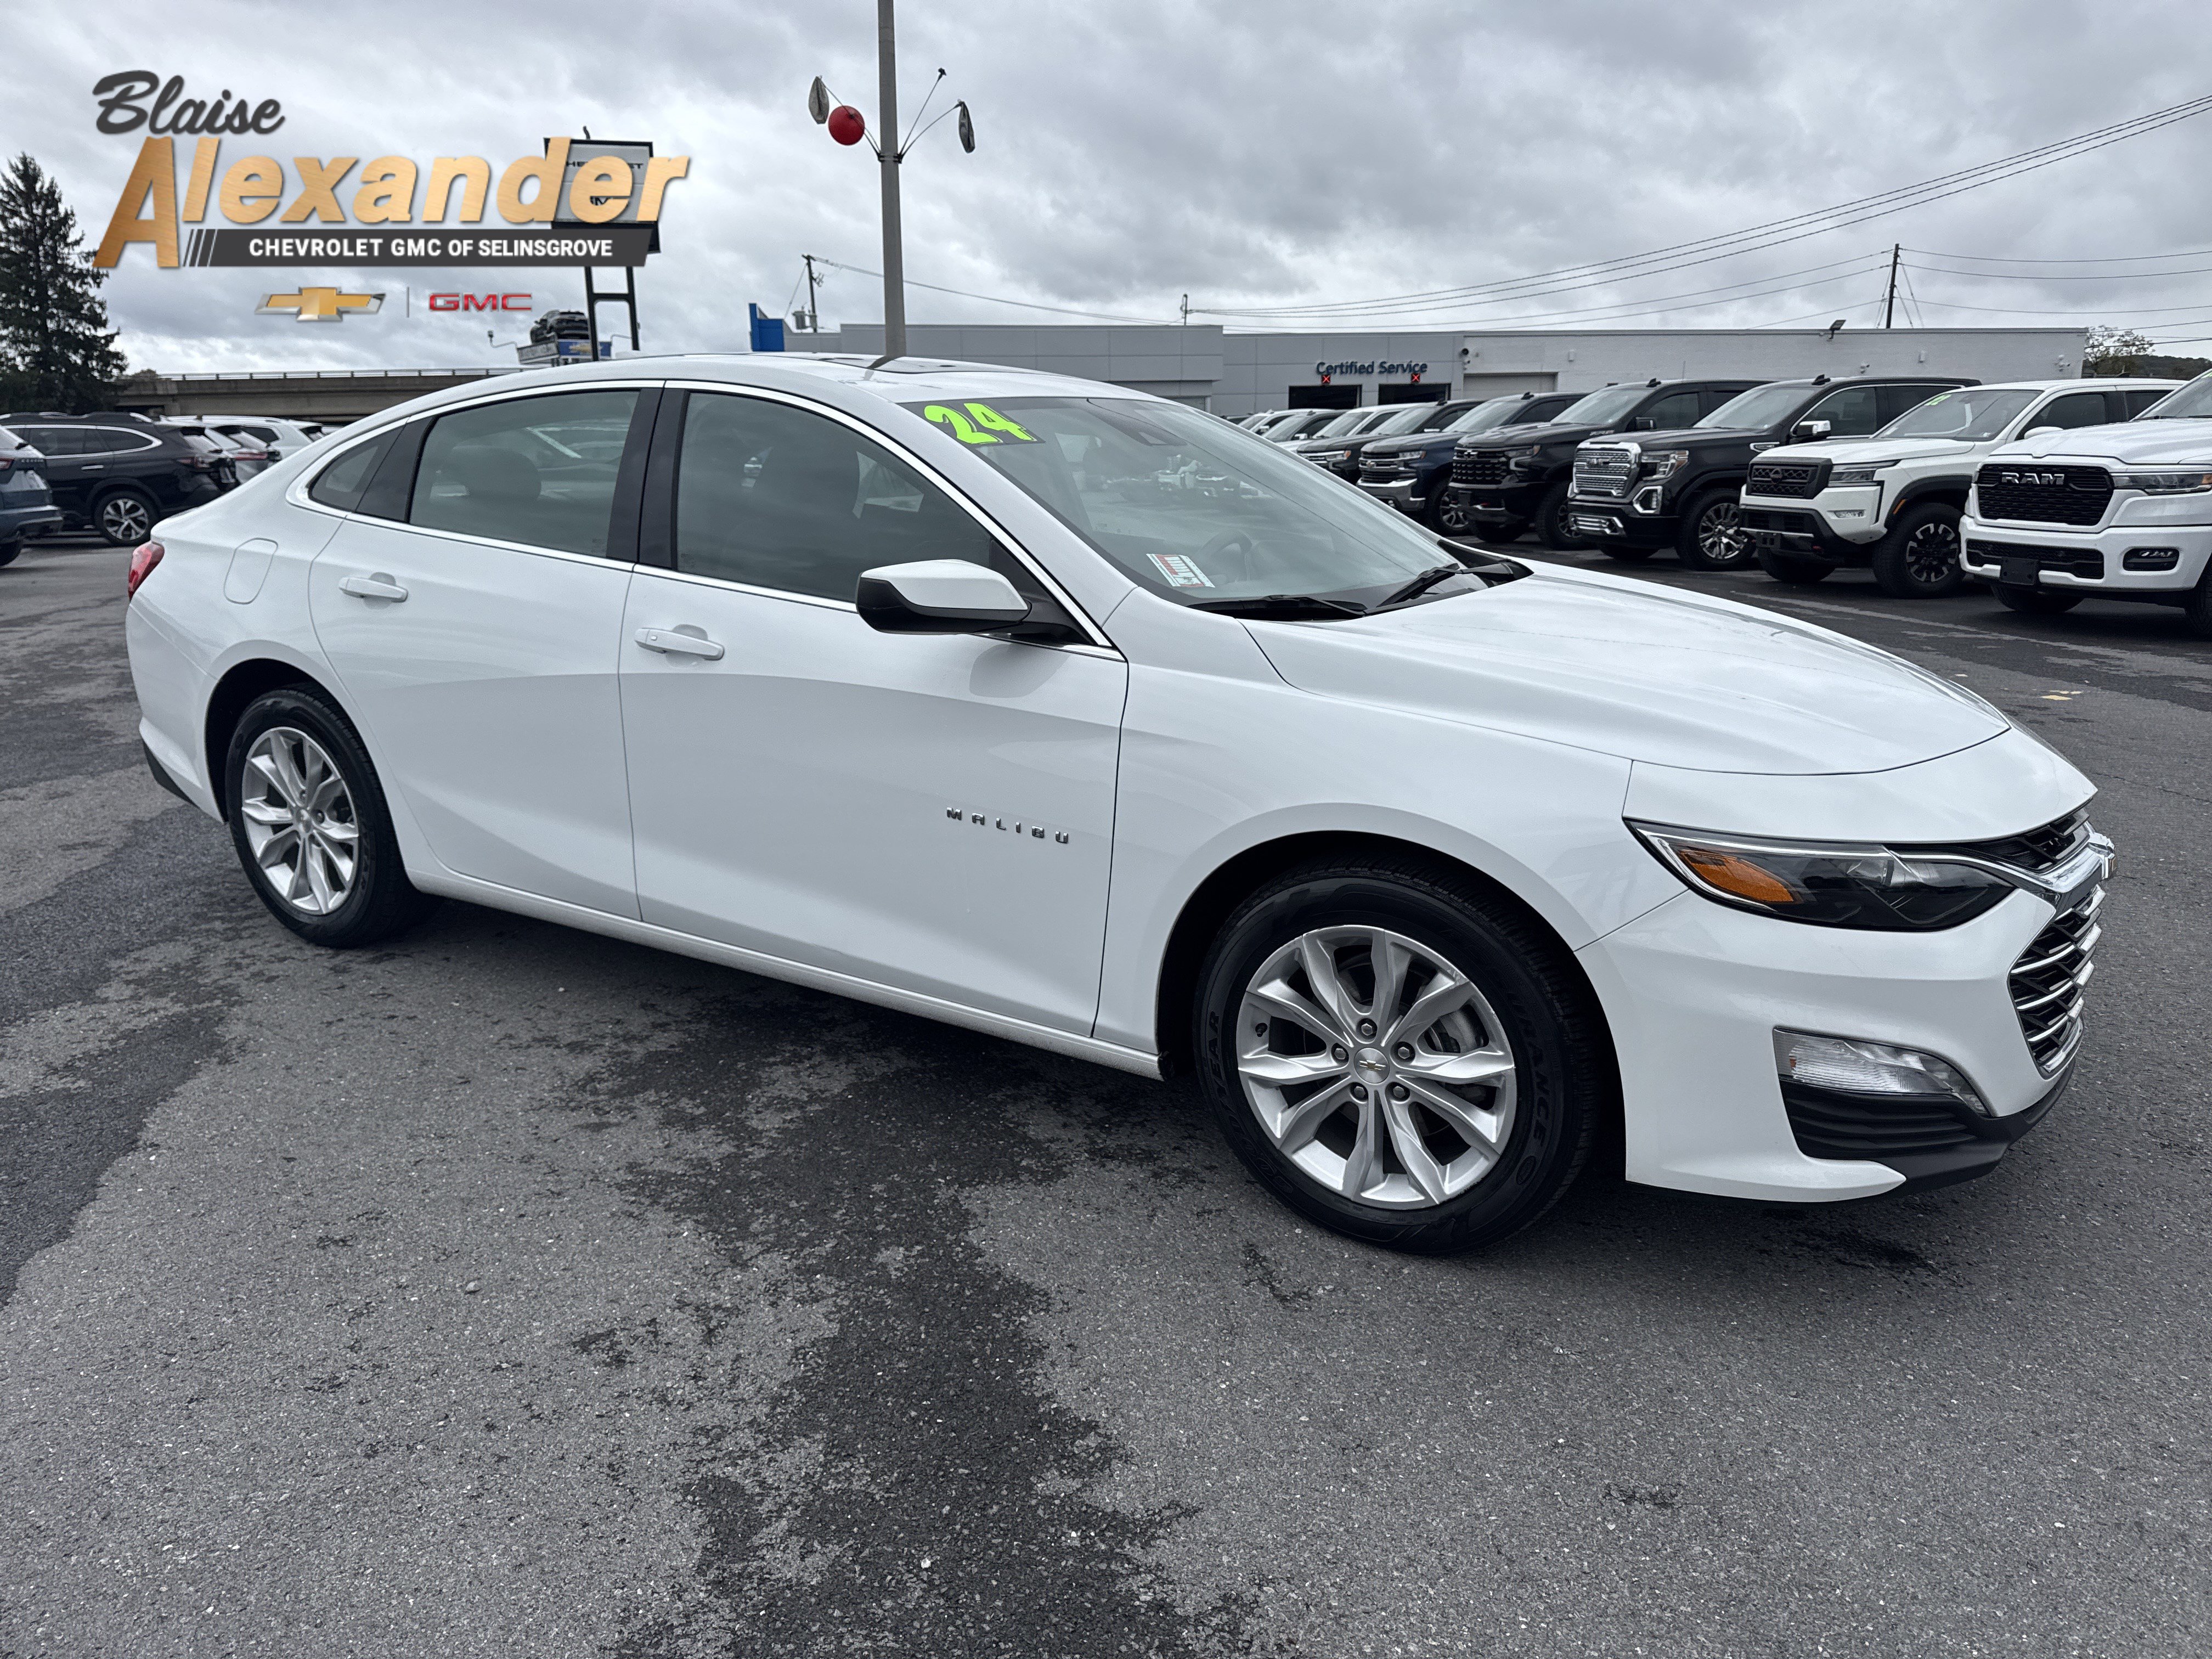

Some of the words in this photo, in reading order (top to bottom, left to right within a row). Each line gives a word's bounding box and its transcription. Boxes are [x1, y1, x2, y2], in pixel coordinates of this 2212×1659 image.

[1316, 361, 1374, 375] Certified
[1378, 360, 1427, 374] Service
[924, 403, 1037, 444] 24
[2001, 472, 2064, 485] RAM
[946, 807, 1069, 844] MALIBU
